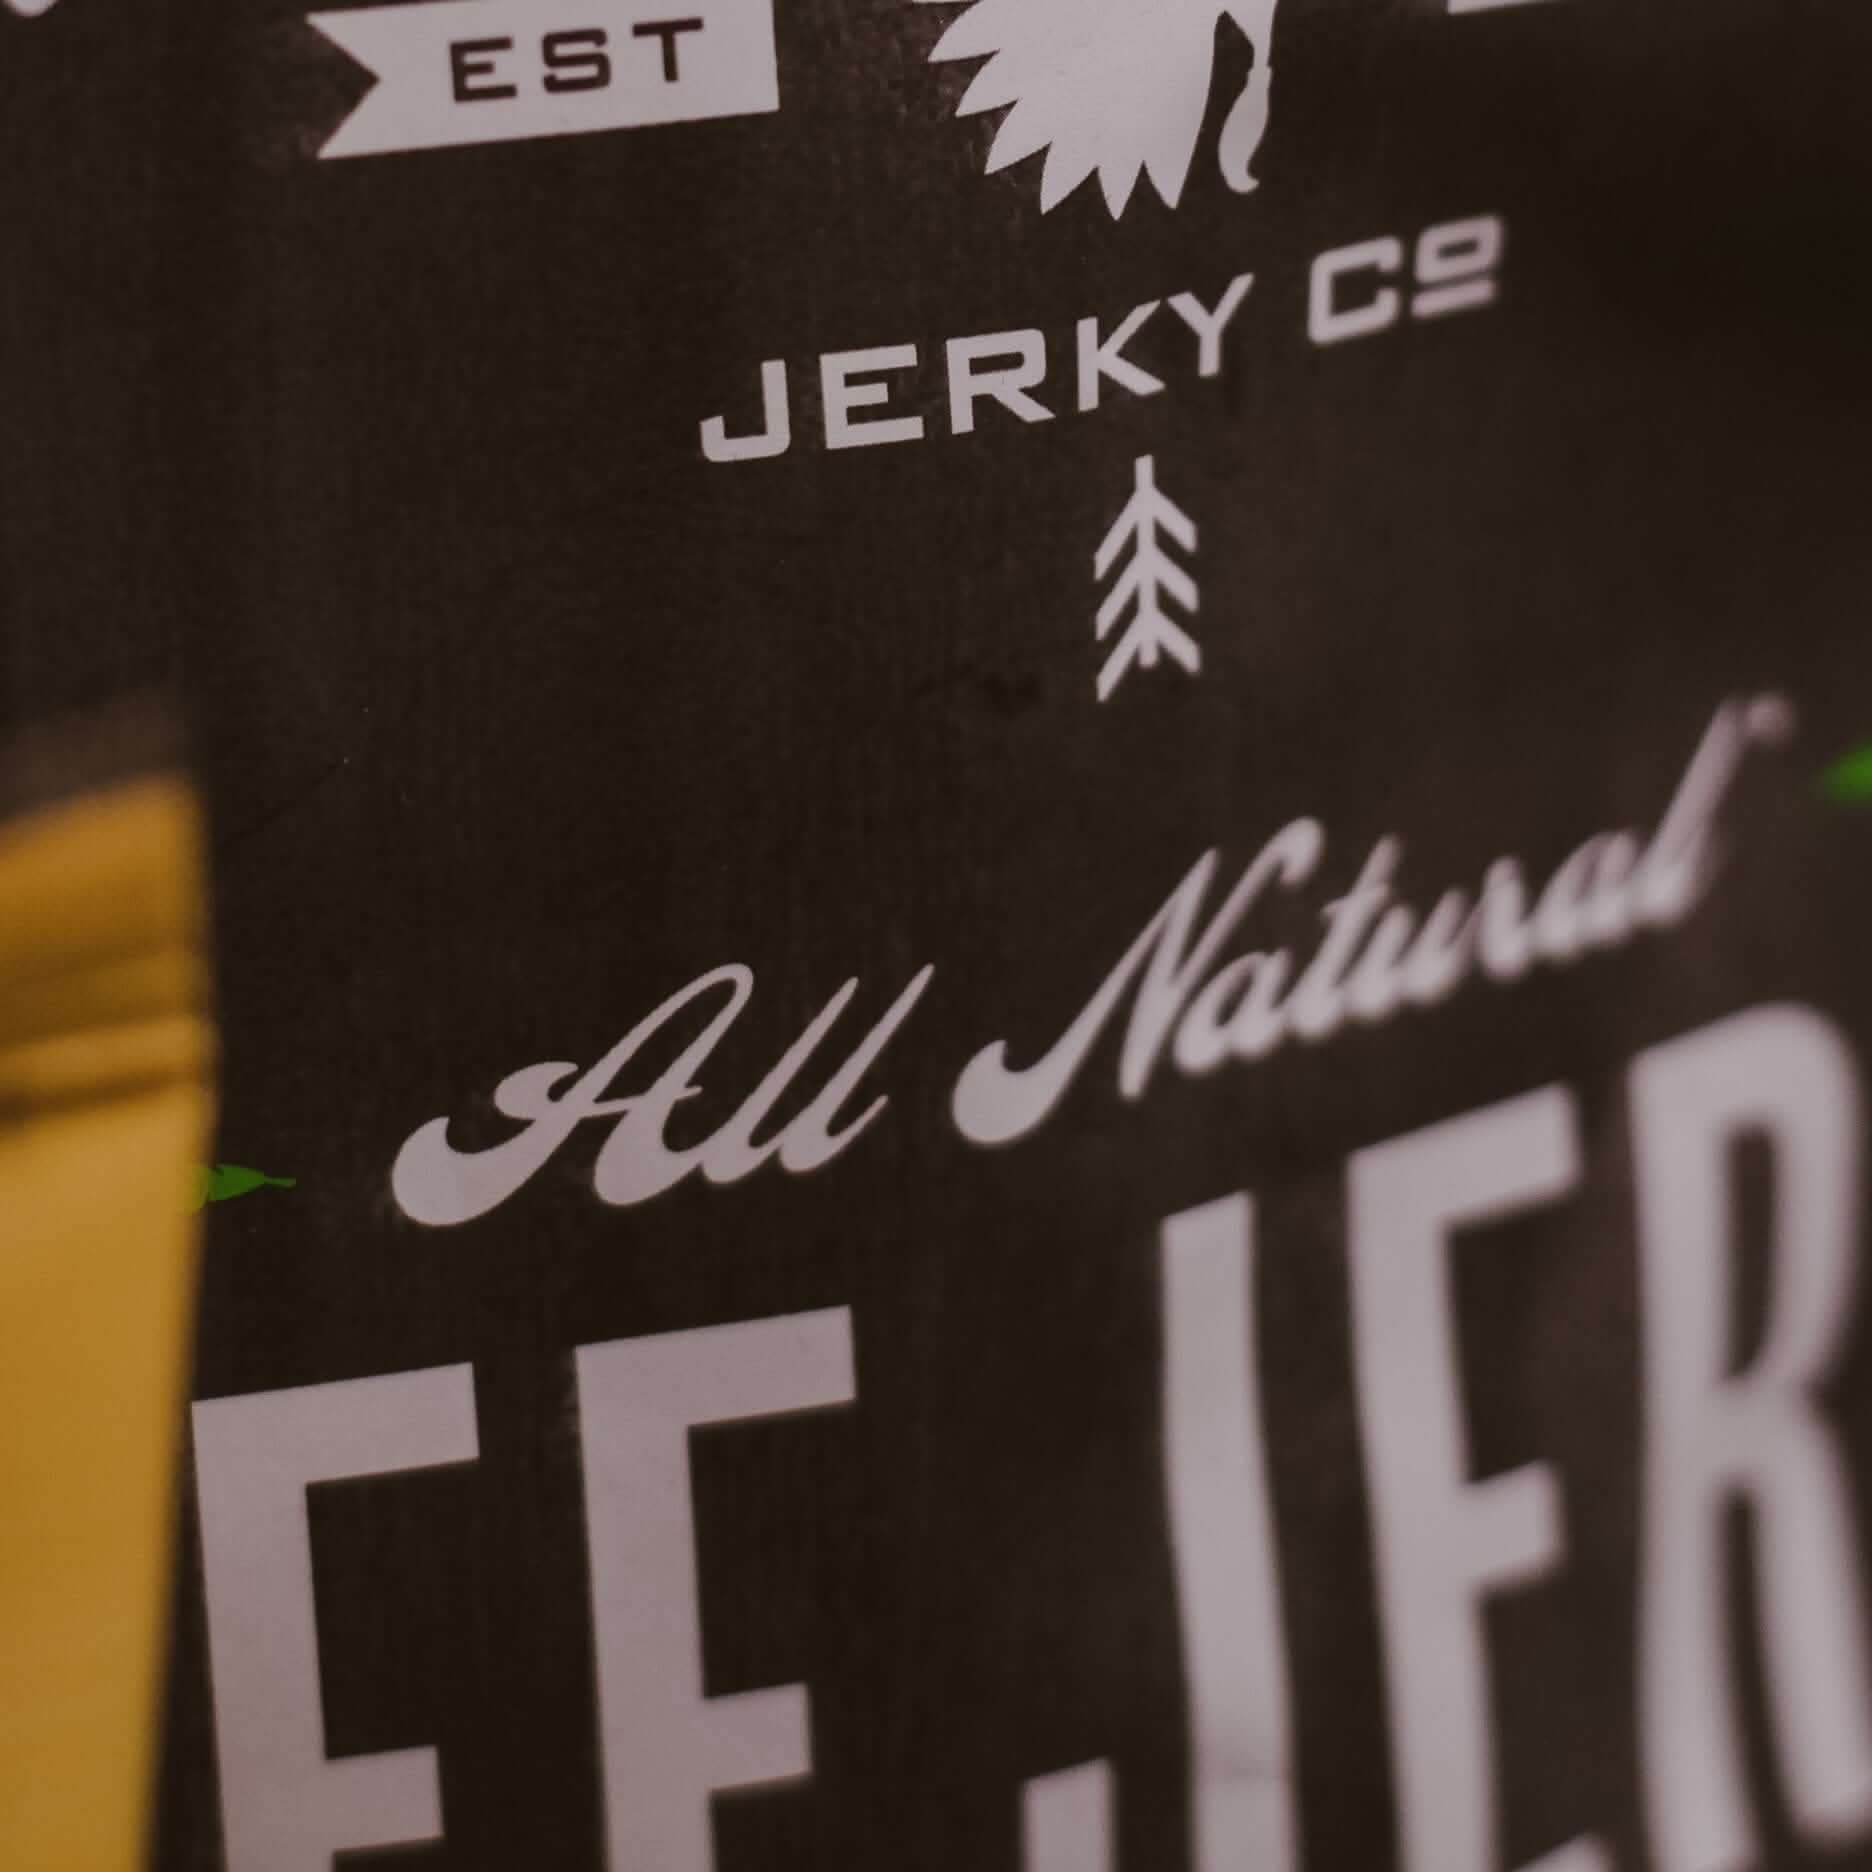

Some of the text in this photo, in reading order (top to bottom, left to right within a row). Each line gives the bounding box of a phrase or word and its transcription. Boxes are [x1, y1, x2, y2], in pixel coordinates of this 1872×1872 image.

[449, 18, 705, 103] EST
[698, 271, 1256, 464] JERKY
[390, 690, 1748, 1228] All Natural
